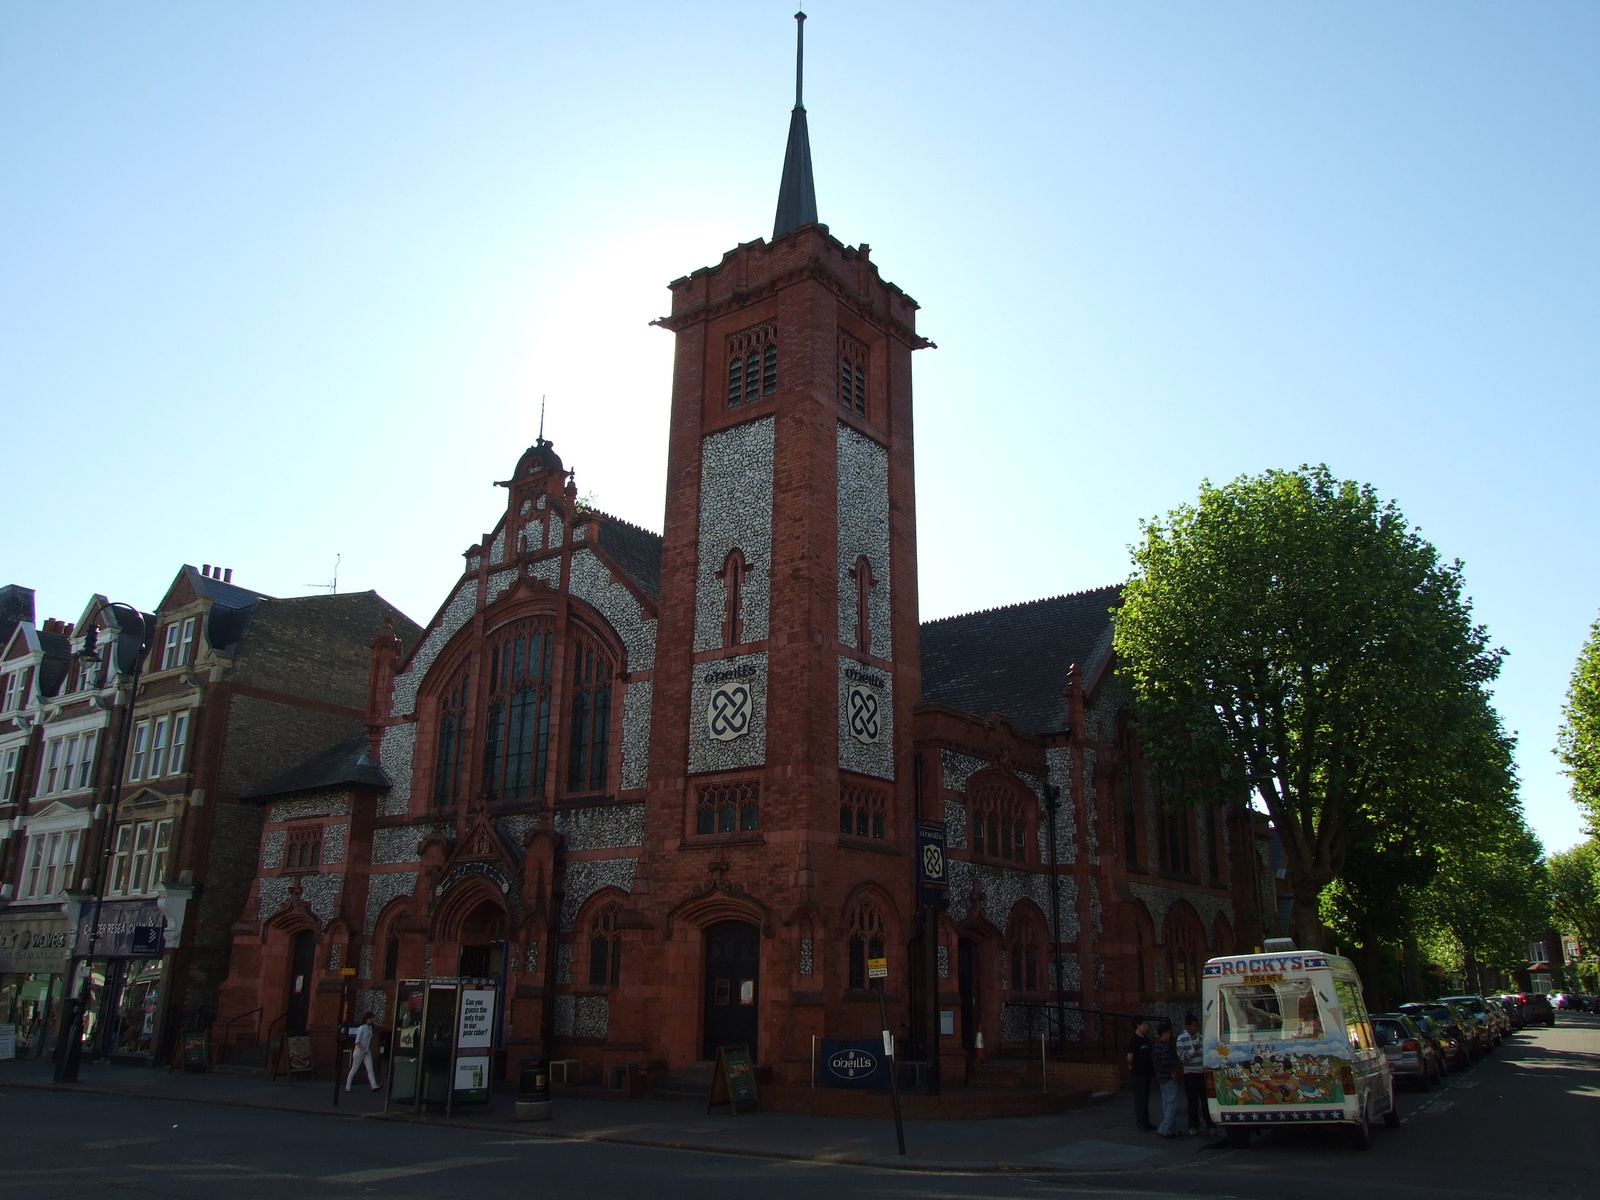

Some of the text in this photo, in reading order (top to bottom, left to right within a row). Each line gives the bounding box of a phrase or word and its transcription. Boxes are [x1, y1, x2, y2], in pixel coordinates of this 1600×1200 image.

[0, 926, 18, 949] air
[1221, 956, 1302, 976] ROCKY'S
[466, 998, 474, 1006] Can
